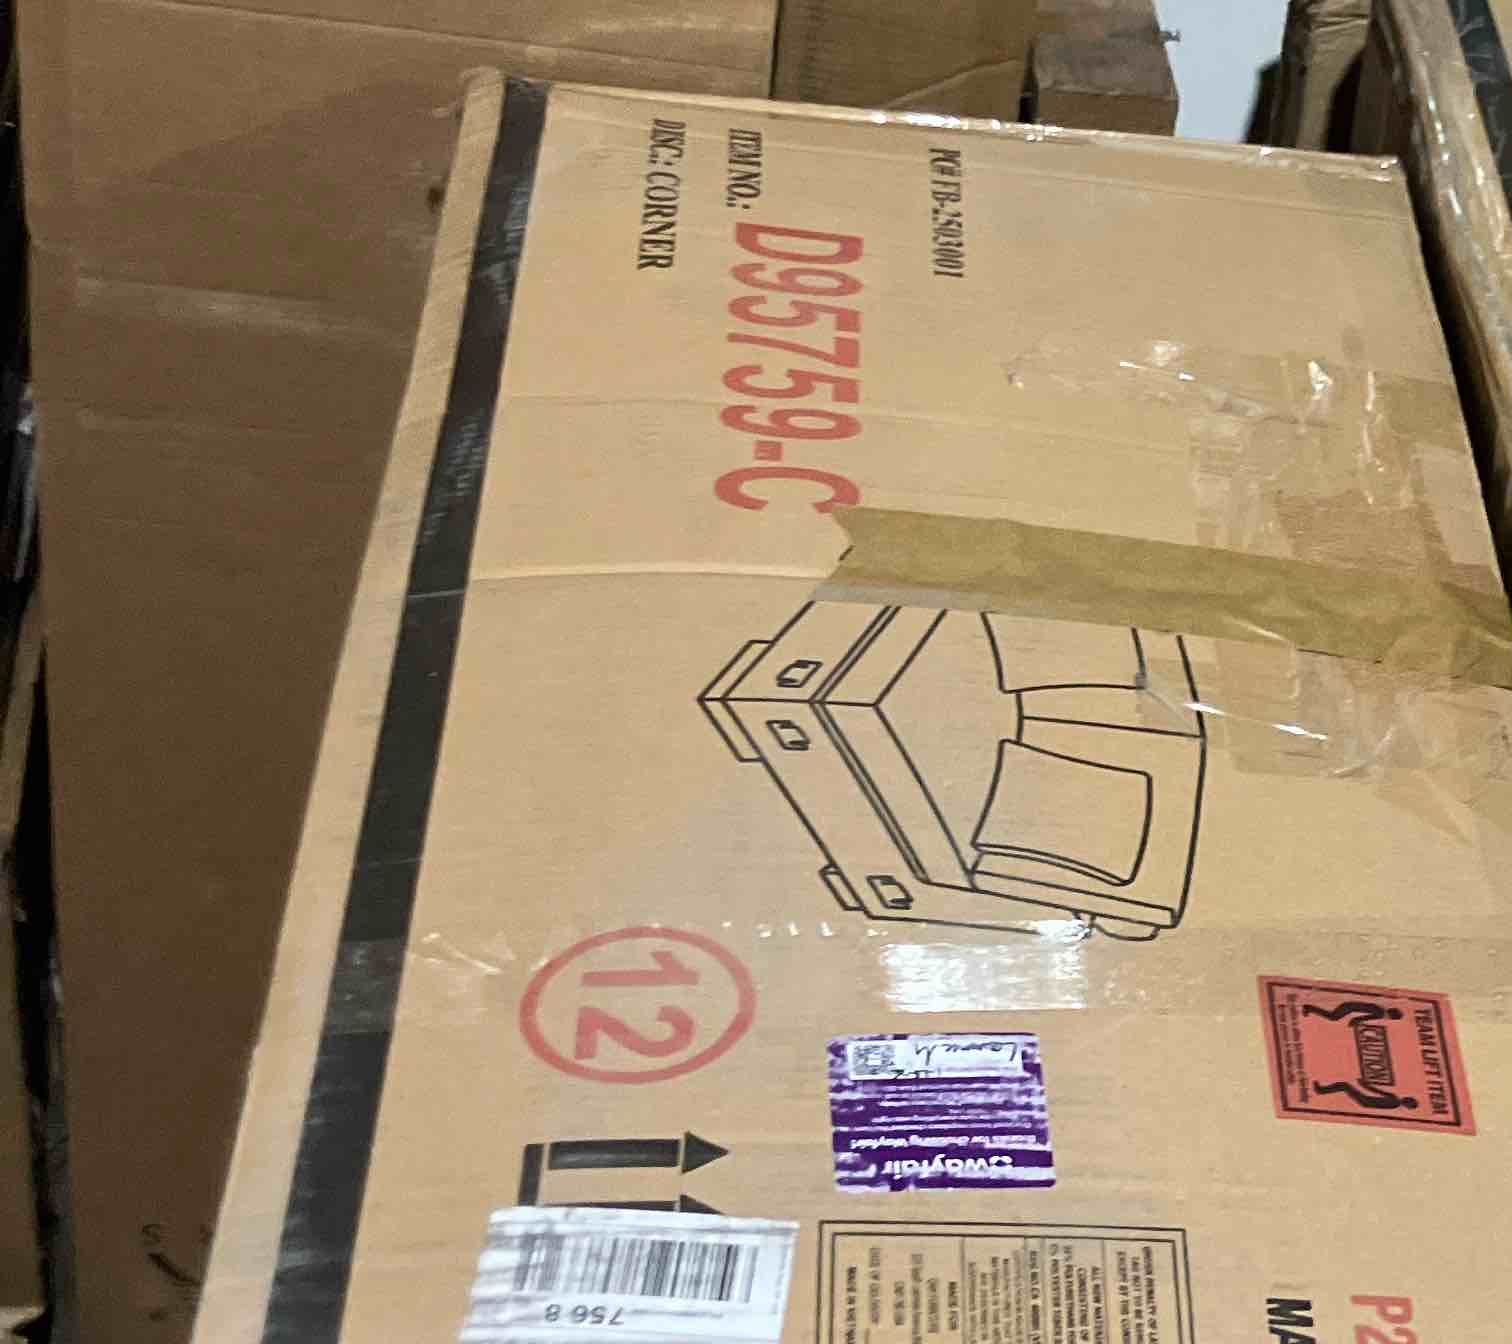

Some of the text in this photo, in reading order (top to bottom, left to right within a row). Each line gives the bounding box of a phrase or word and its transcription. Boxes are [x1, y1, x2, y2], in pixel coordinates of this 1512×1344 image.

[727, 128, 763, 168] ITEM
[636, 171, 682, 271] CORNER
[714, 221, 865, 514] D95759-C
[572, 949, 701, 1061] 12
[1359, 1026, 1391, 1082] CAUTION
[1414, 1009, 1449, 1115] TEAM LIFT ITEM
[881, 1154, 990, 1181] wayfair
